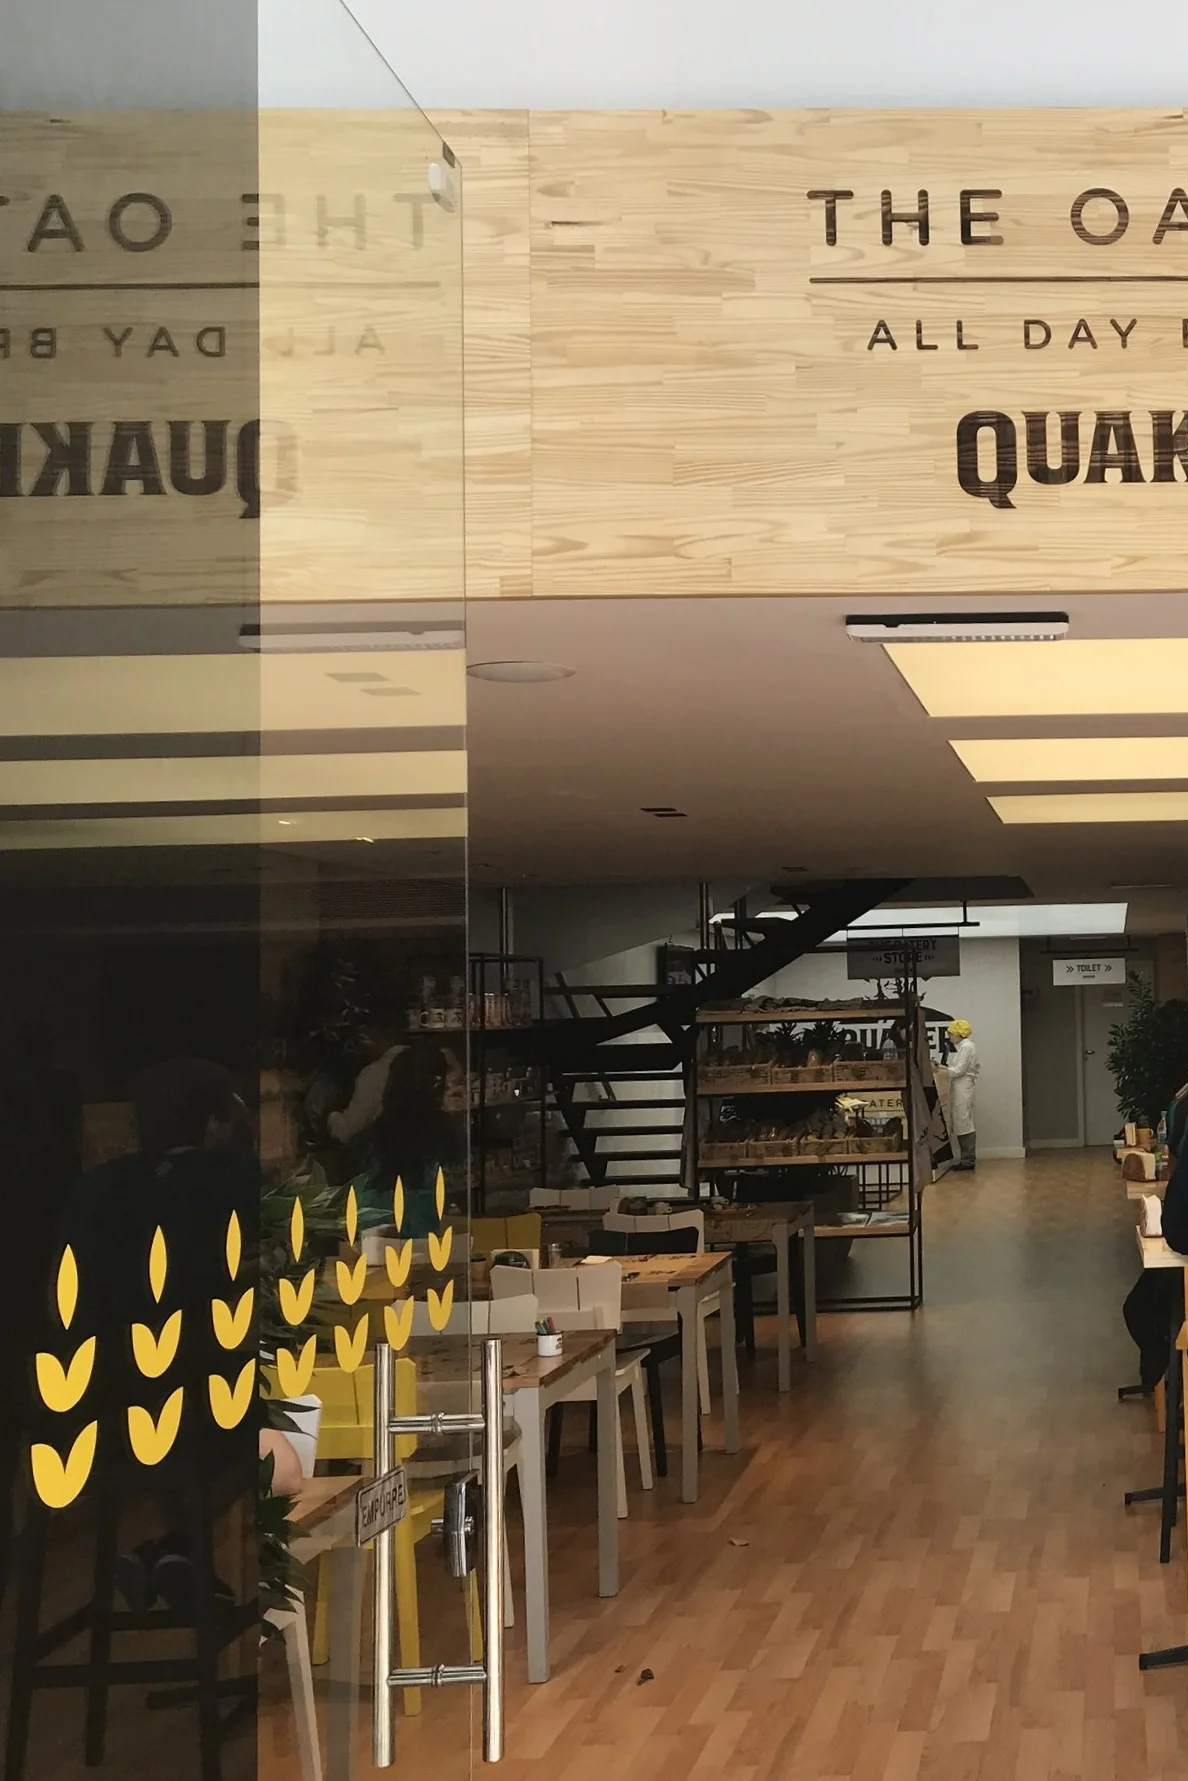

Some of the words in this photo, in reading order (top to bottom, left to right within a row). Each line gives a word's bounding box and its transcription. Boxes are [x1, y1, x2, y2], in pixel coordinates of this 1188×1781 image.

[807, 188, 1004, 246] THE
[867, 319, 979, 351] ALL
[1023, 318, 1139, 350] DAY
[1076, 964, 1101, 972] TOILET
[362, 1484, 404, 1527] EMPURRE
